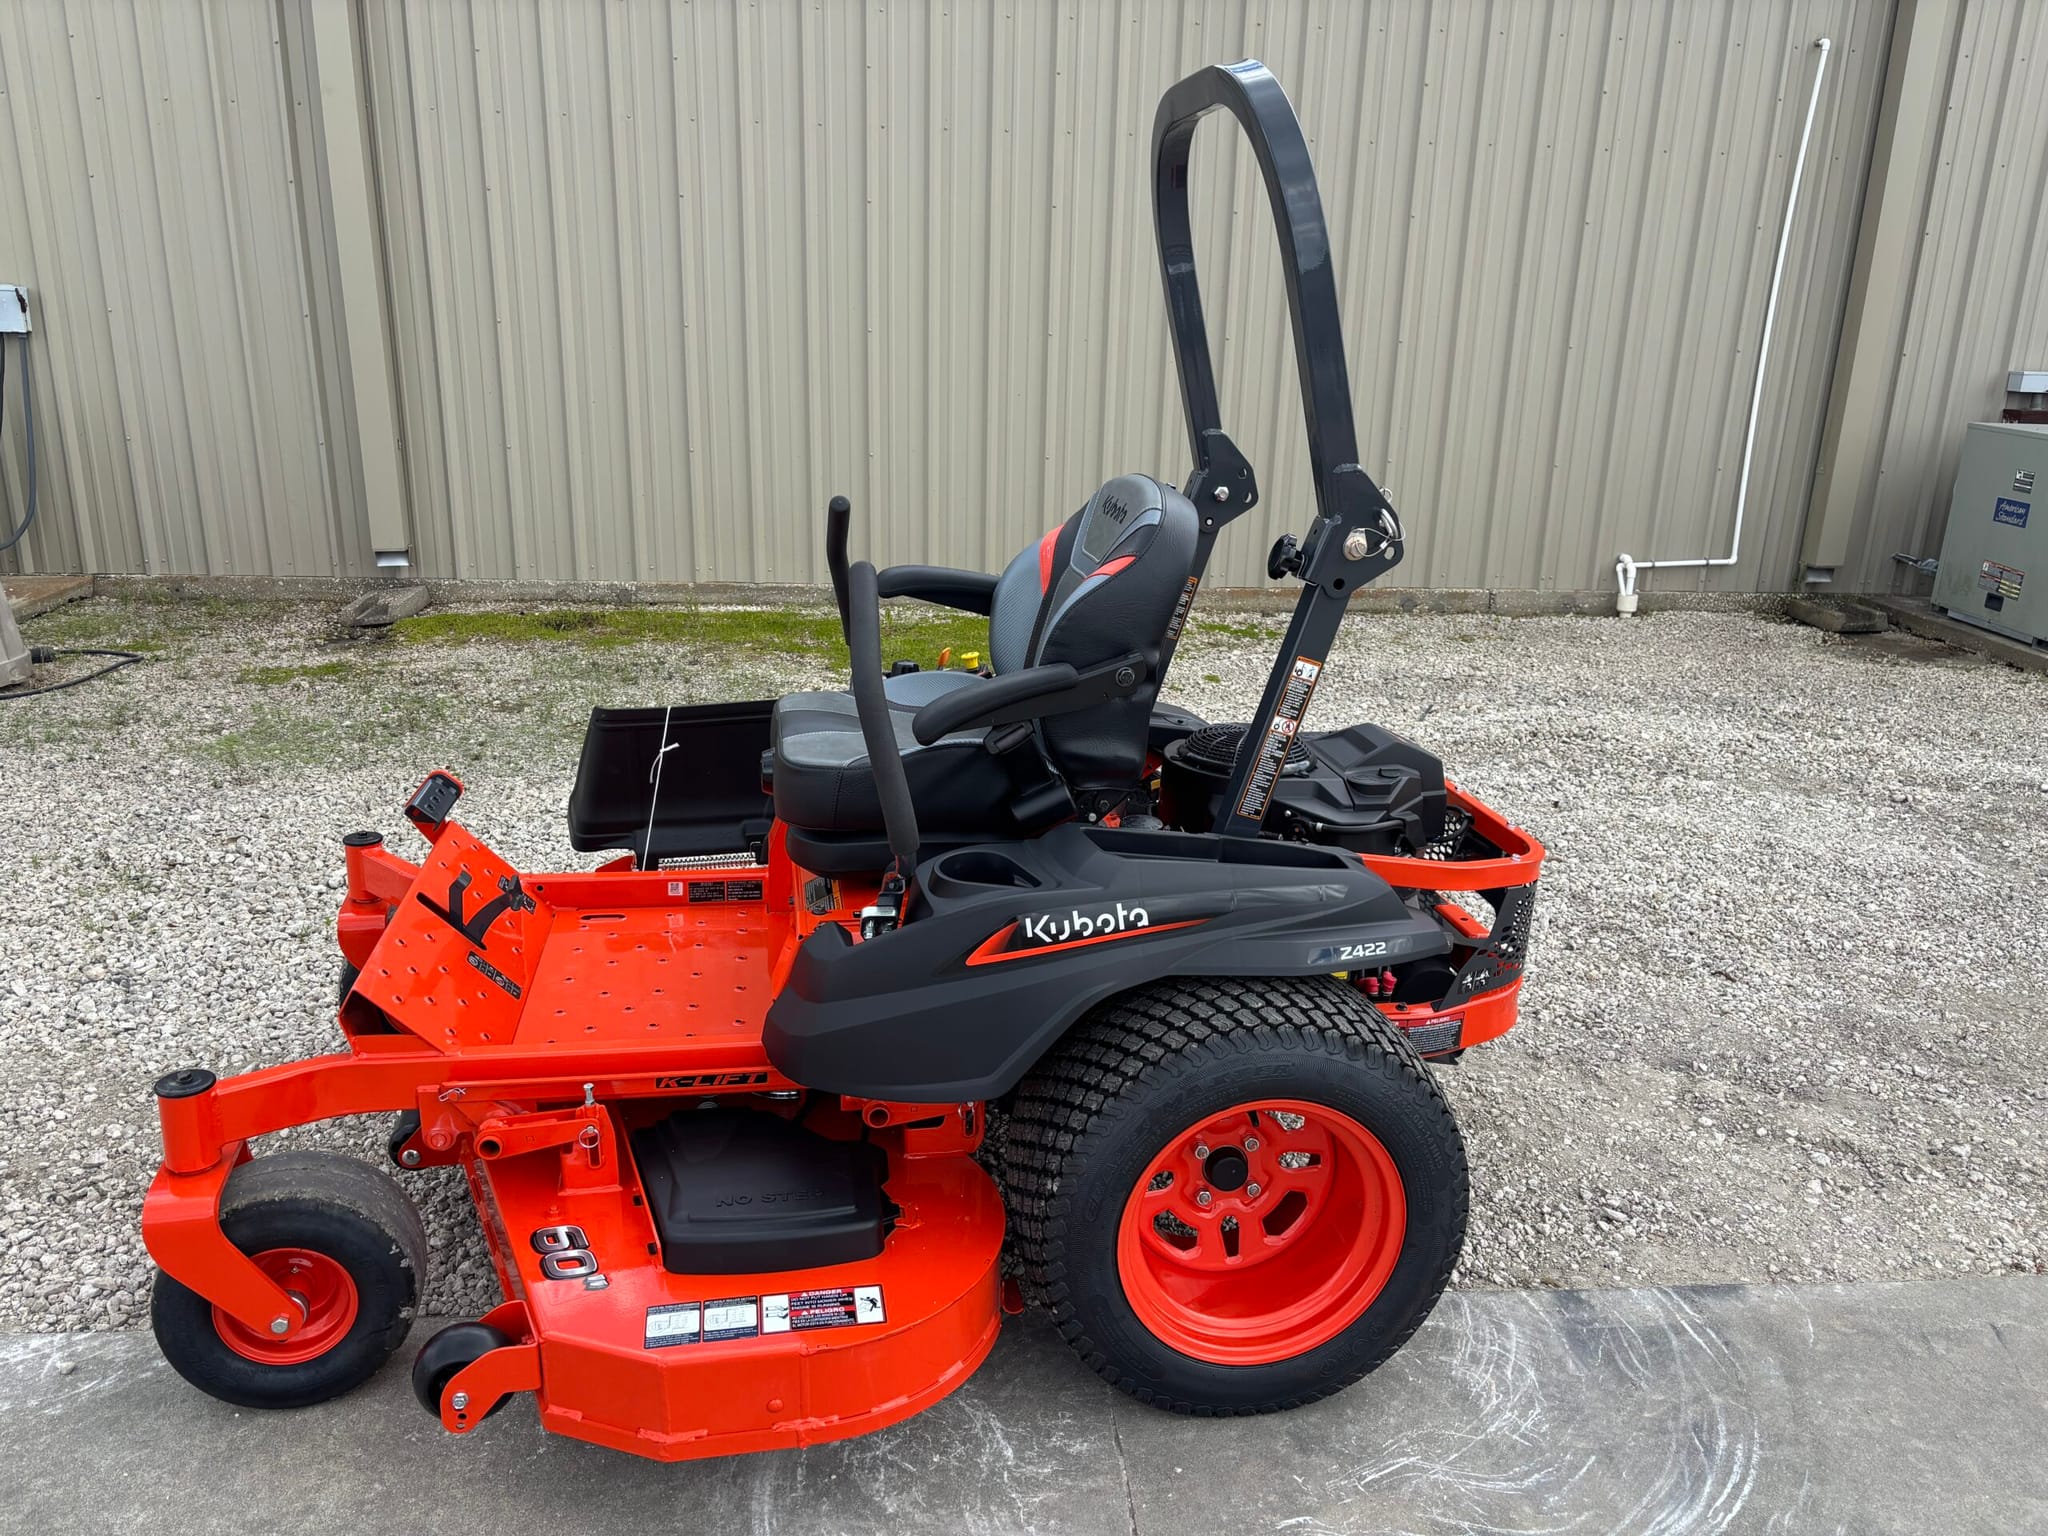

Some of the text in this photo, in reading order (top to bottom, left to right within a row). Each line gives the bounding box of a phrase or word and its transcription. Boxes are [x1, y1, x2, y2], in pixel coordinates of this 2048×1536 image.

[1025, 902, 1149, 942] Kubota
[1340, 941, 1387, 961] Z422
[658, 1072, 765, 1088] K-LIFT
[716, 1189, 825, 1208] NO STEP
[809, 1307, 845, 1315] PELIGRO
